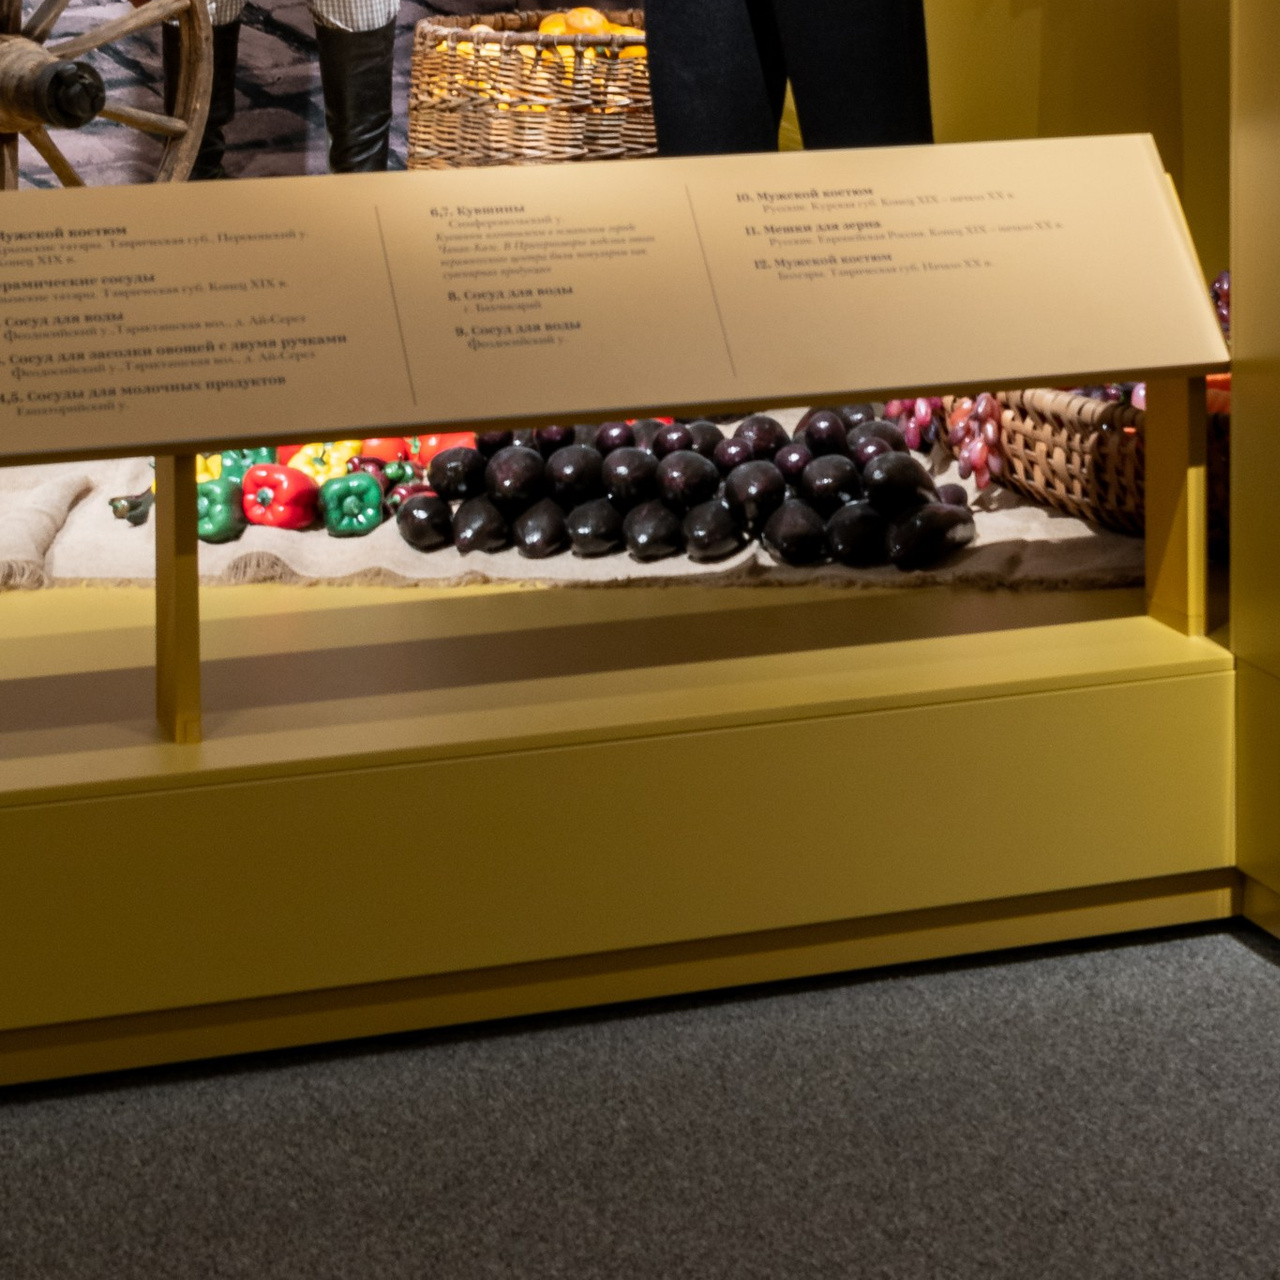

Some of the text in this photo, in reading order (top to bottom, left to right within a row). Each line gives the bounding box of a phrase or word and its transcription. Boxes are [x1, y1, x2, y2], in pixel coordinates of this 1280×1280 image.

[757, 188, 819, 204] Мужской
[822, 186, 873, 198] костюм
[69, 225, 127, 238] костюм
[763, 223, 812, 235] Мешки
[816, 222, 839, 233] для
[774, 254, 837, 270] Мужской
[841, 252, 892, 264] костюм
[101, 272, 155, 287] сосуды
[464, 289, 504, 302] Сосуд
[471, 324, 511, 337] Сосуд
[58, 351, 85, 362] для
[230, 338, 276, 352] двумя
[281, 333, 347, 349] ручками
[89, 386, 117, 399] для
[120, 380, 202, 396] молочных
